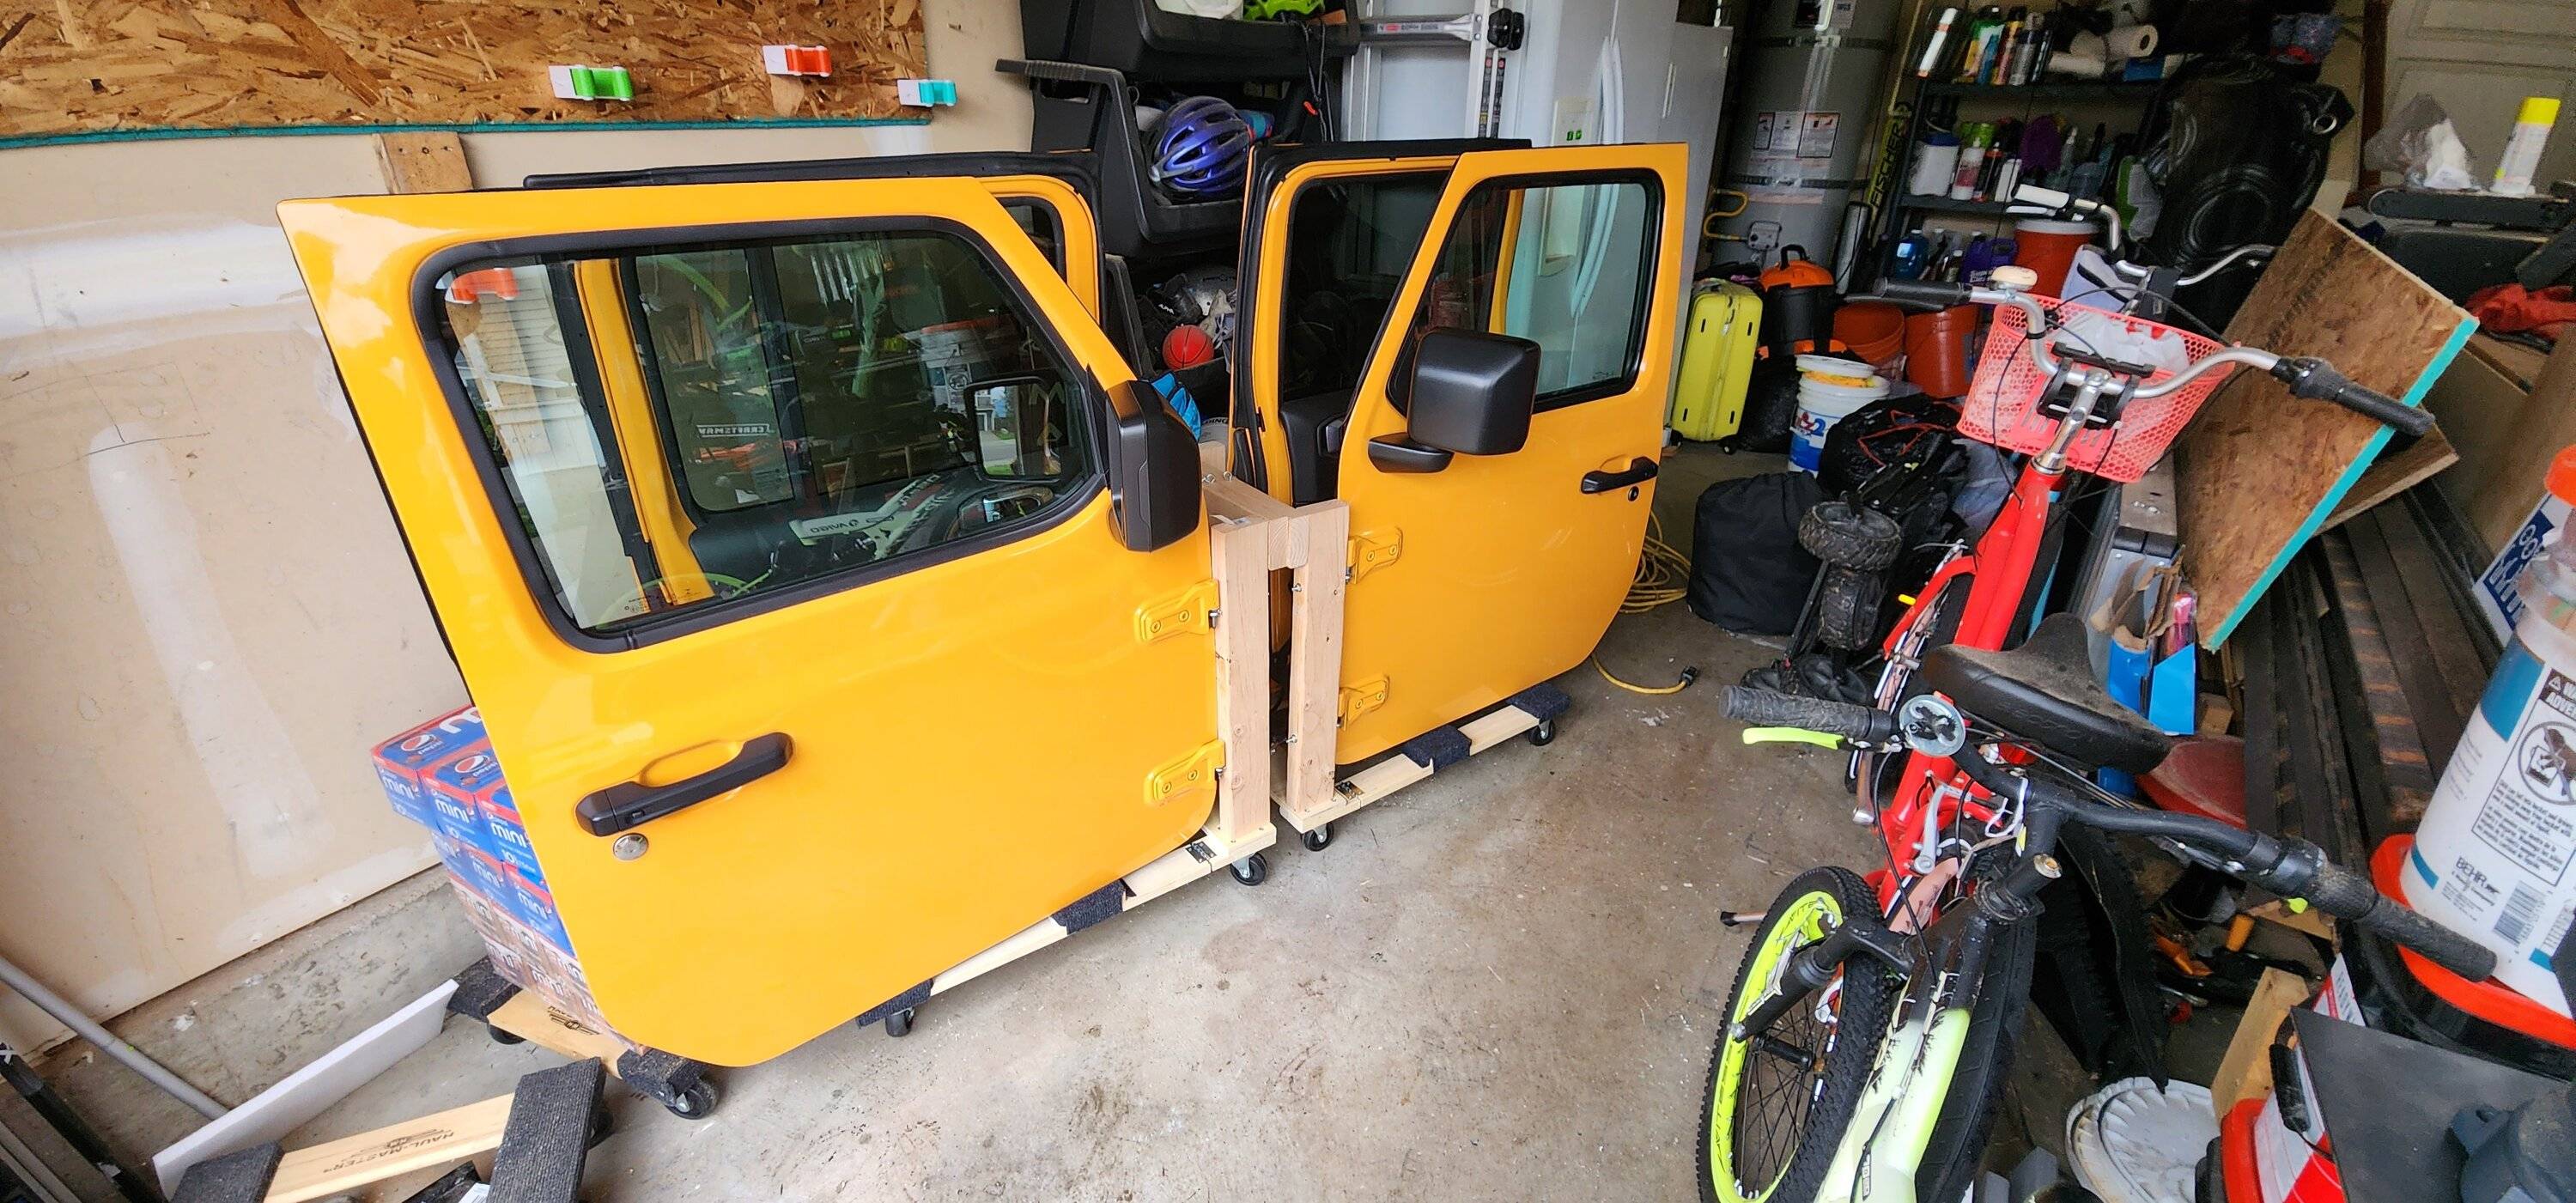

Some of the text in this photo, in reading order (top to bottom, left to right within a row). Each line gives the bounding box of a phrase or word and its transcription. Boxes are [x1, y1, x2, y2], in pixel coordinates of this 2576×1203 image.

[382, 776, 415, 799] mini
[434, 799, 470, 823] mini
[490, 823, 527, 848] mini
[2455, 856, 2488, 888] BEHR
